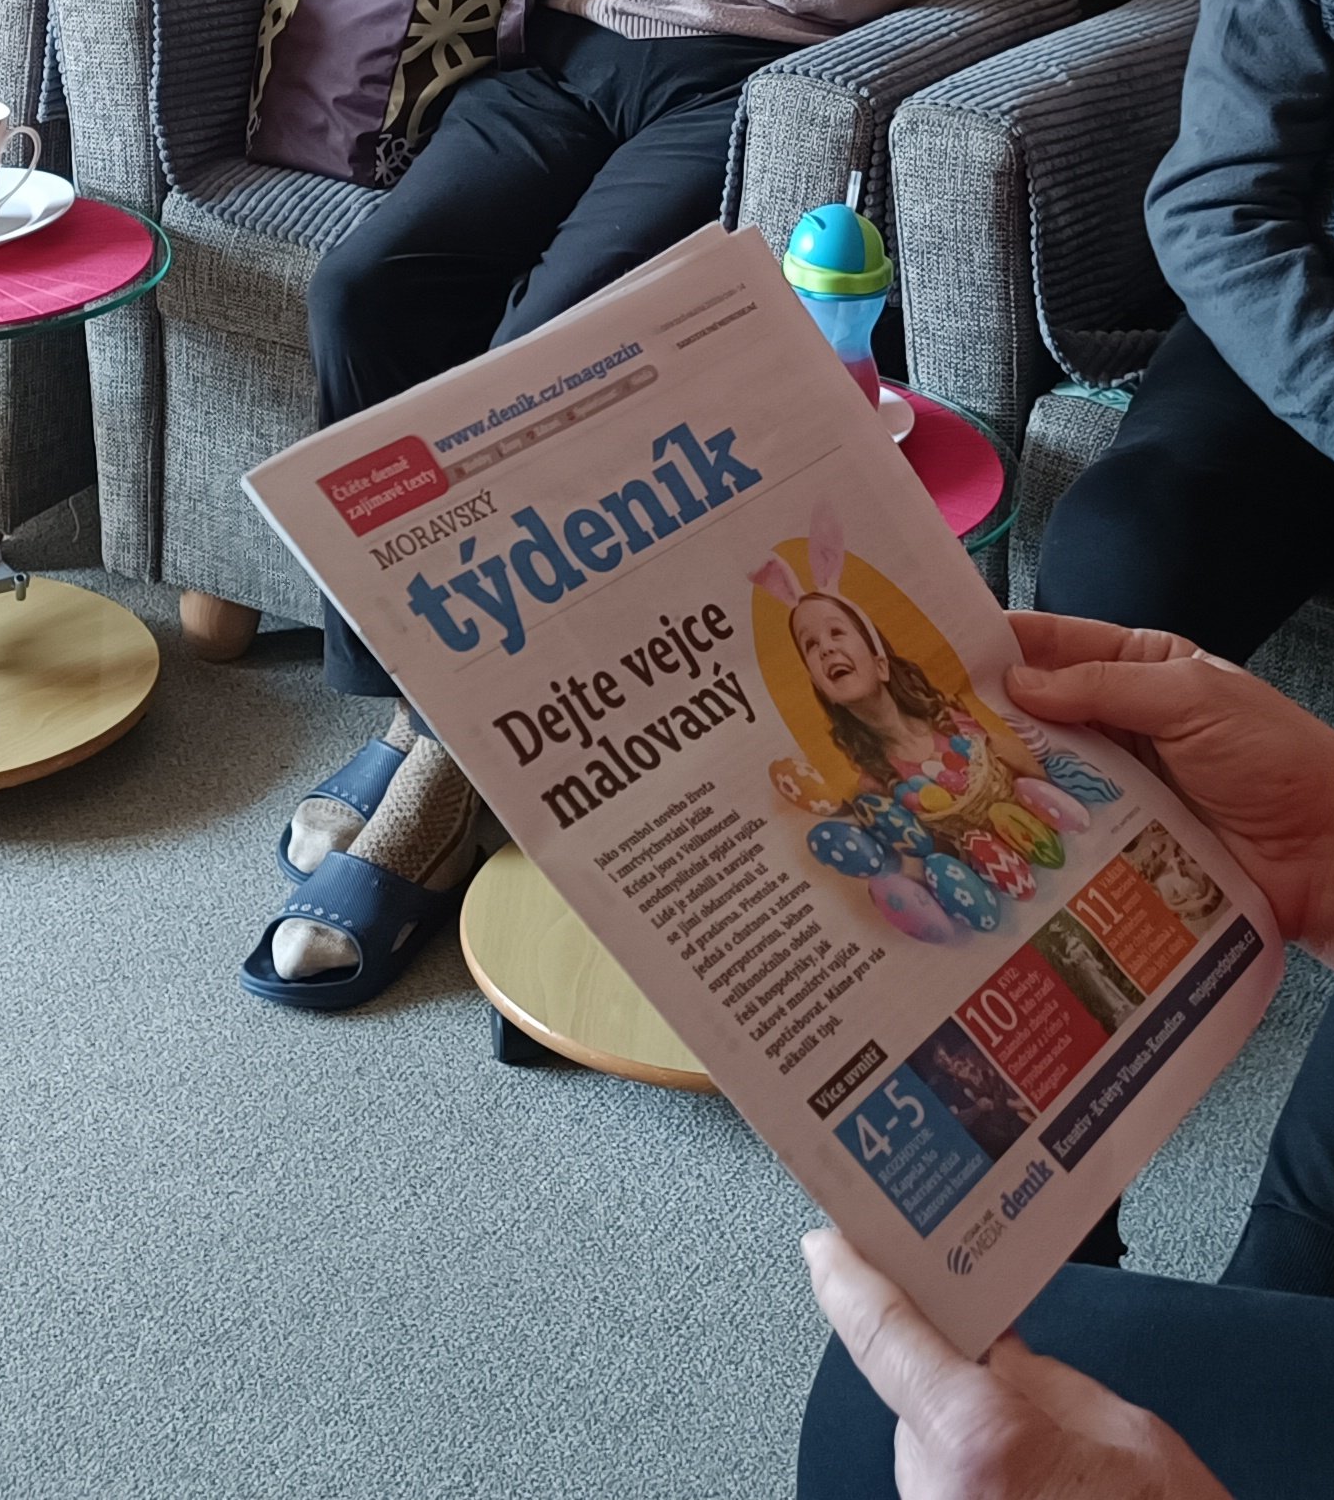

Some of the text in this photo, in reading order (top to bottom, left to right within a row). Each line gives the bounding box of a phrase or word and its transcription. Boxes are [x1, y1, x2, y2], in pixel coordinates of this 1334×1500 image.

[330, 454, 410, 502] Čtěte denně
[346, 468, 438, 521] zajímavé texty
[368, 488, 499, 571] MORAVSKÝ
[406, 422, 763, 656] týdeník
[491, 603, 735, 768] Dejte vejce
[540, 661, 756, 830] malovaný
[593, 779, 715, 871] Jako symbol nového života
[615, 820, 690, 880] zmrtvýchvstání
[685, 804, 715, 830] Ježíše
[622, 870, 657, 898] Krista
[653, 854, 679, 878] jsou
[679, 808, 741, 855] Velikonocemi
[637, 855, 711, 914] neodmyslitelně
[707, 836, 737, 863] spjatá
[650, 841, 765, 929] Lidé je zdobili a navzájem
[666, 930, 681, 945] se
[677, 911, 703, 937] jimi
[753, 861, 768, 876] už
[679, 942, 697, 961] od
[738, 878, 779, 913] Přestože
[776, 871, 789, 884] se
[779, 901, 814, 931] během
[1075, 886, 1124, 936] 11
[691, 879, 811, 980] jedná o chutnou a zdravou
[733, 1000, 759, 1026] řeší
[812, 938, 833, 960] jak
[748, 940, 862, 1042] takové množství vajíček
[823, 974, 855, 1003] Máme
[852, 961, 872, 981] pro
[867, 946, 886, 964] vás
[777, 1034, 820, 1075] několik
[965, 988, 1018, 1048] 10
[814, 1046, 881, 1110] Více uvnitř
[855, 1078, 925, 1162] 4-5
[996, 1157, 1055, 1221] deník
[968, 1218, 1008, 1260] MEDIA
